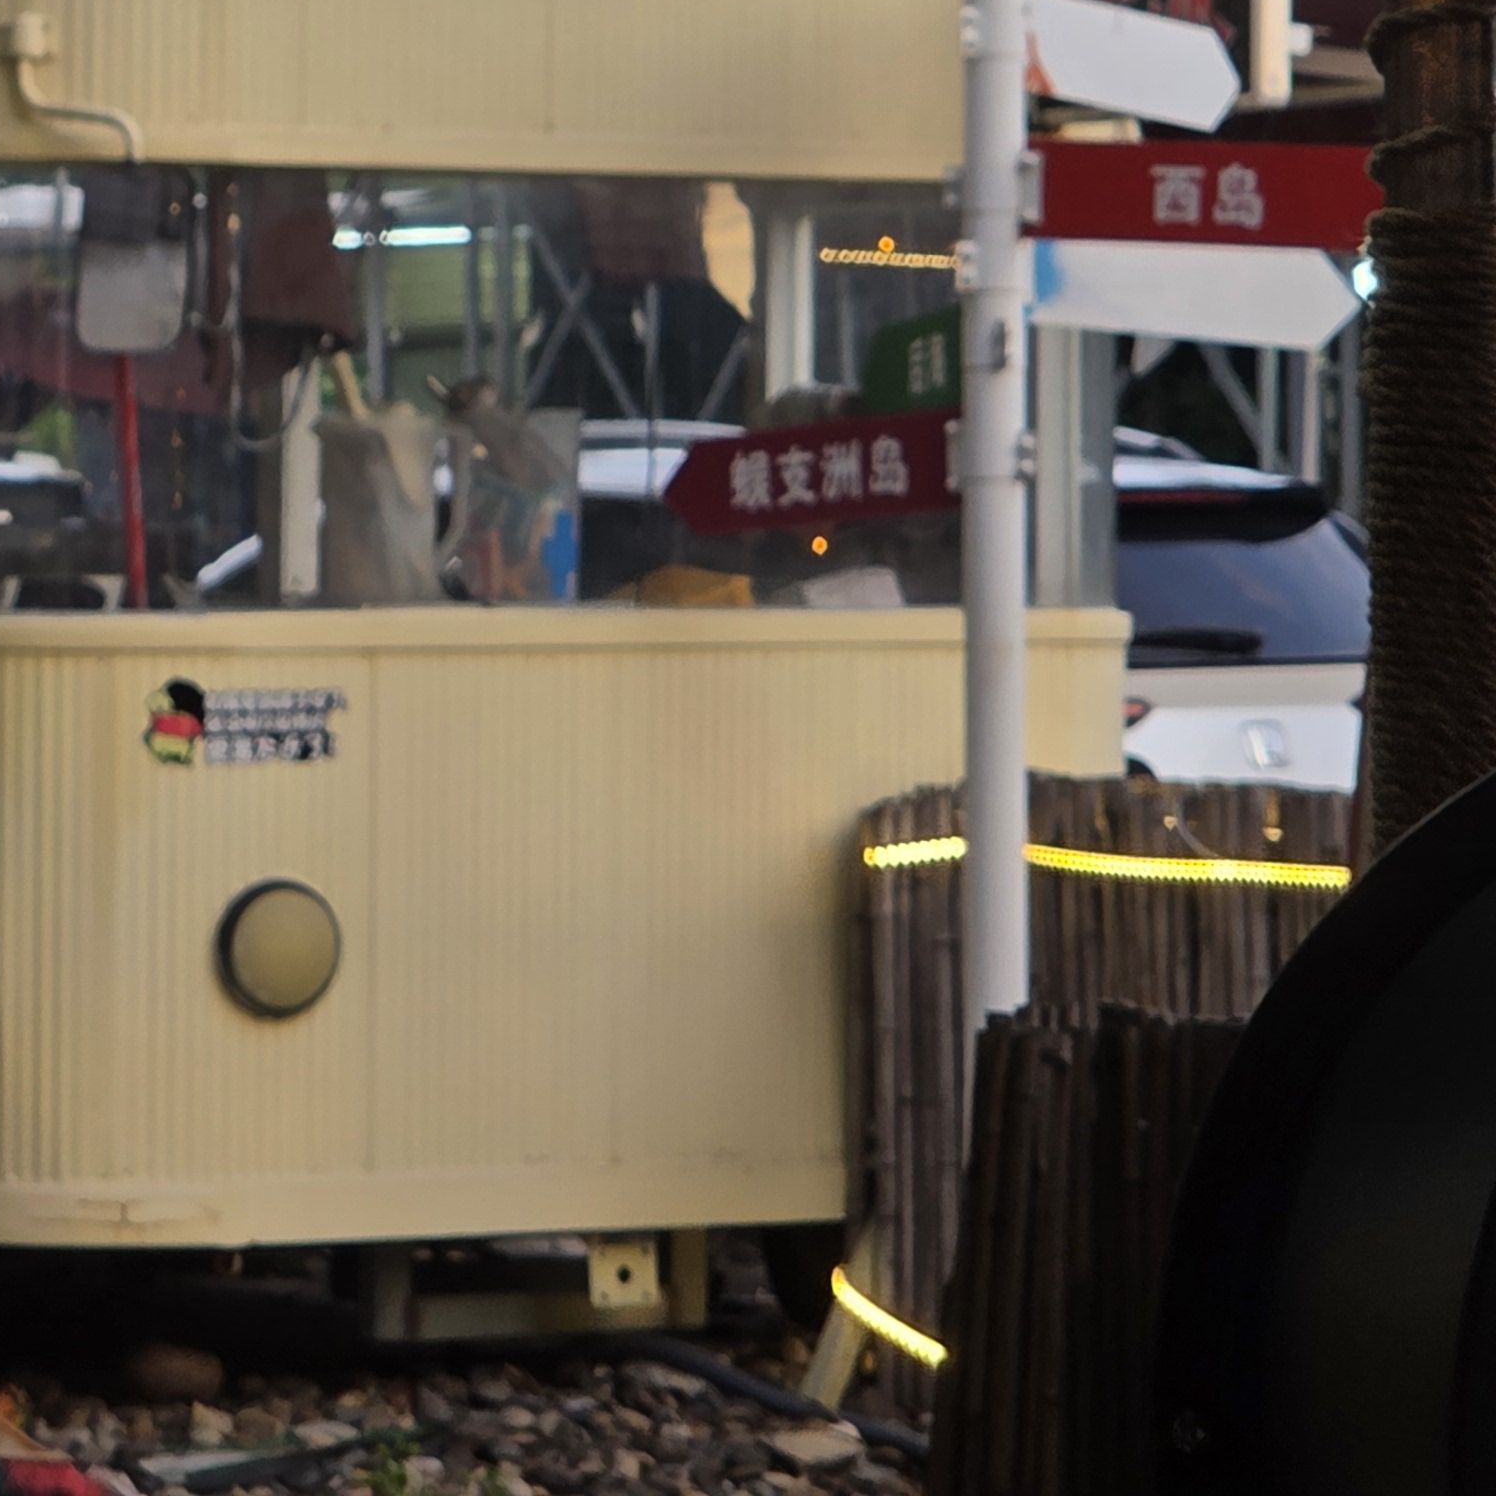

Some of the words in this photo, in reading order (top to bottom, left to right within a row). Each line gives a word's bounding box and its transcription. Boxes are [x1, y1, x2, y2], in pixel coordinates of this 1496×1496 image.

[1152, 162, 1266, 229] 西岛
[729, 435, 910, 512] 蜈支洲岛
